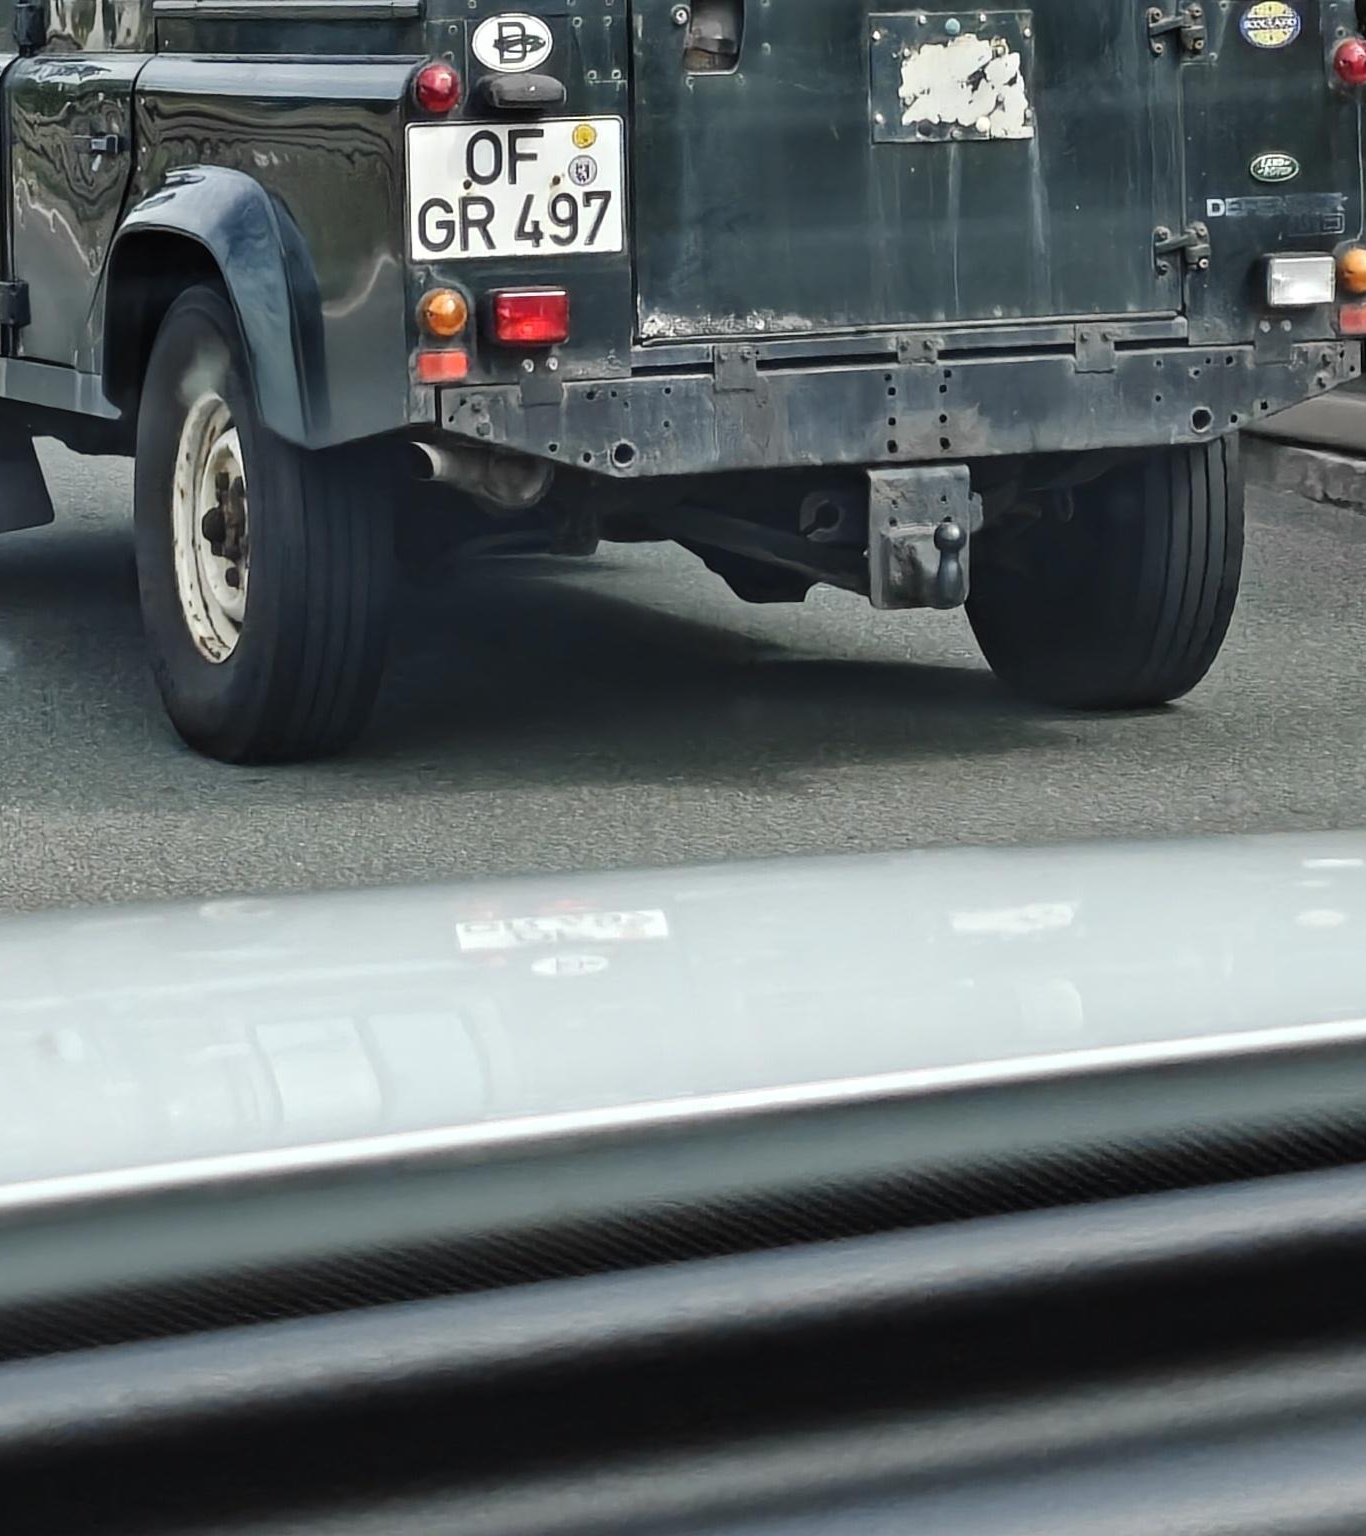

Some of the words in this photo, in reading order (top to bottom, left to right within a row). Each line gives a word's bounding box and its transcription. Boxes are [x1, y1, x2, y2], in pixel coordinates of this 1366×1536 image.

[466, 129, 544, 185] OF
[418, 196, 496, 253] GR
[514, 191, 612, 249] 497
